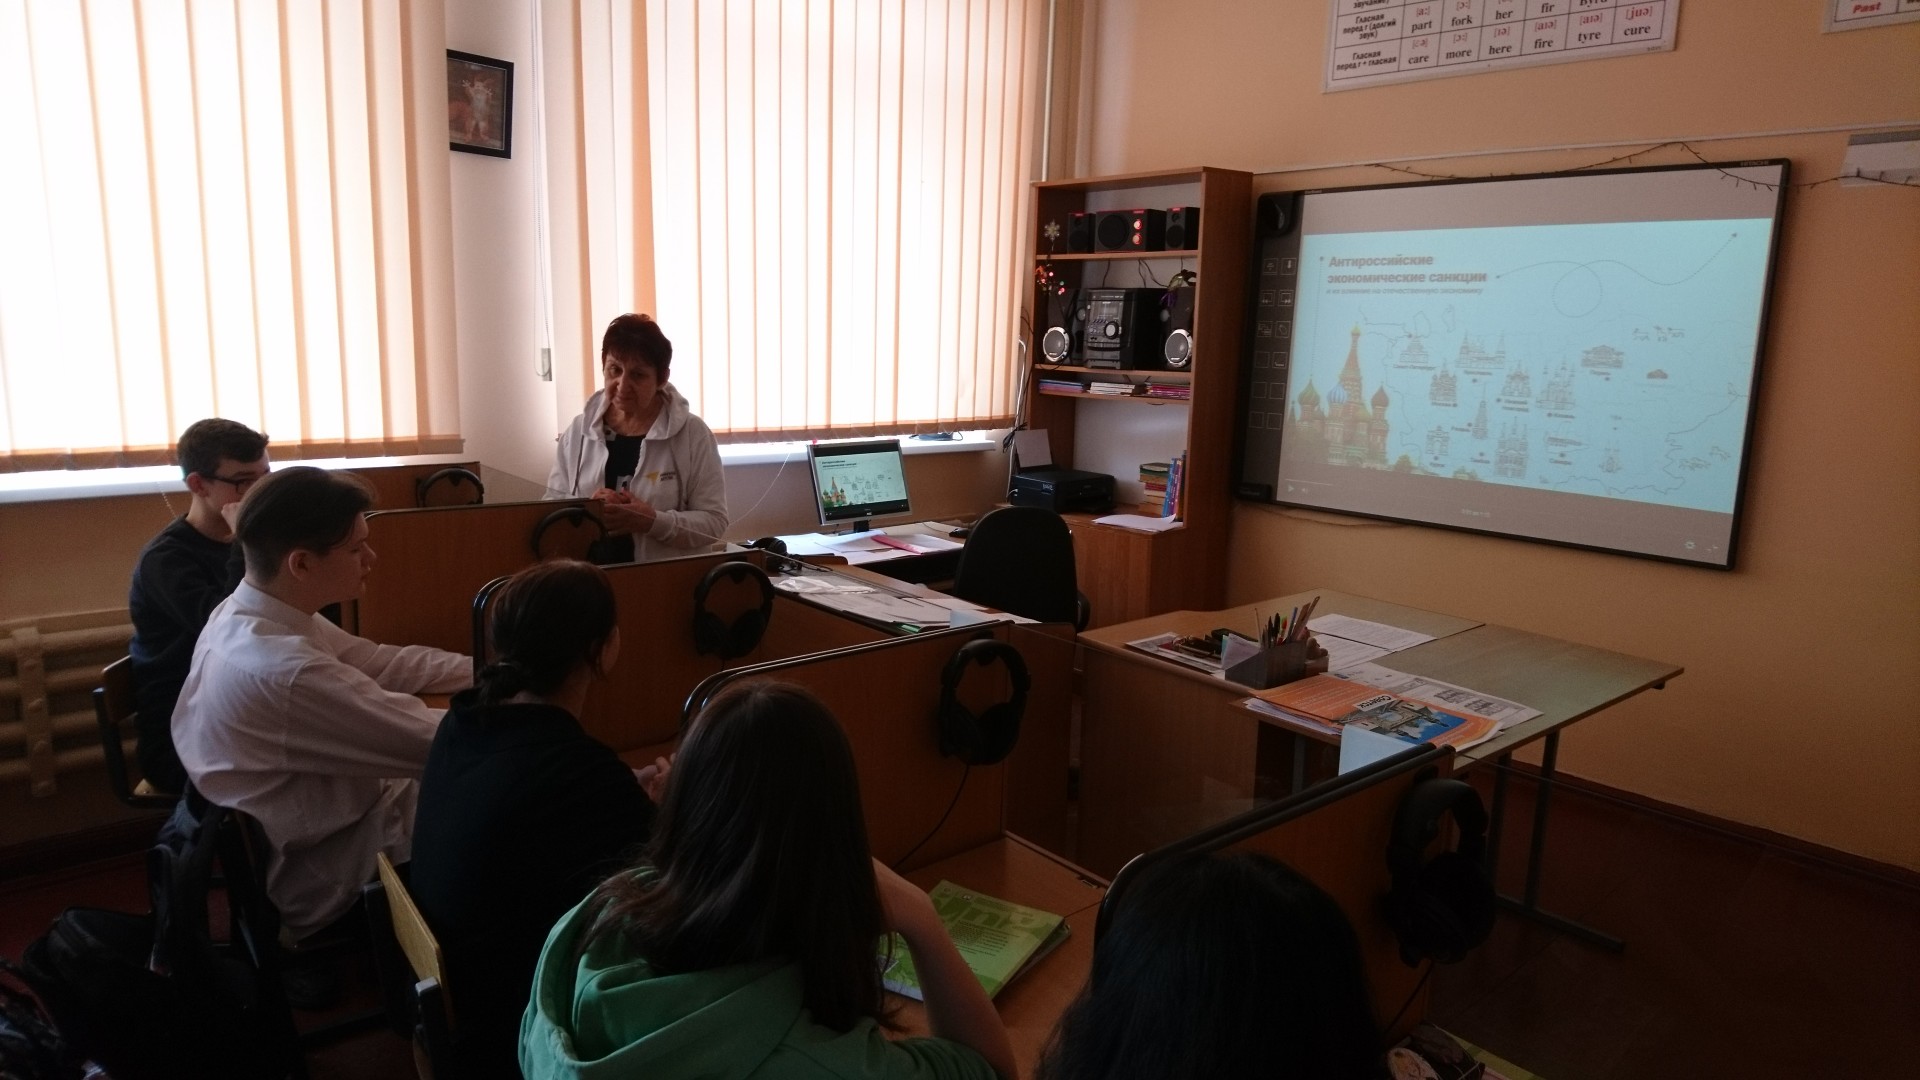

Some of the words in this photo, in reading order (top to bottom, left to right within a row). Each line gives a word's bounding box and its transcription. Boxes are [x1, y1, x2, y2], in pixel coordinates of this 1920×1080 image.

[1541, 2, 1555, 13] fir
[1853, 2, 1881, 13] Past
[1355, 14, 1385, 24] Гласная
[1495, 9, 1514, 20] her
[1411, 20, 1433, 33] part
[1451, 15, 1473, 27] fork
[1359, 30, 1378, 40] звук)
[1623, 24, 1651, 36] cure
[1577, 30, 1601, 44] tyre
[1534, 38, 1554, 49] fire
[1352, 50, 1381, 60] Гласная
[1445, 48, 1472, 59] more
[1489, 44, 1512, 55] here
[1408, 54, 1430, 65] care
[1329, 253, 1434, 269] Антироссийские
[1327, 272, 1426, 284] экономические
[1428, 272, 1487, 284] санкции
